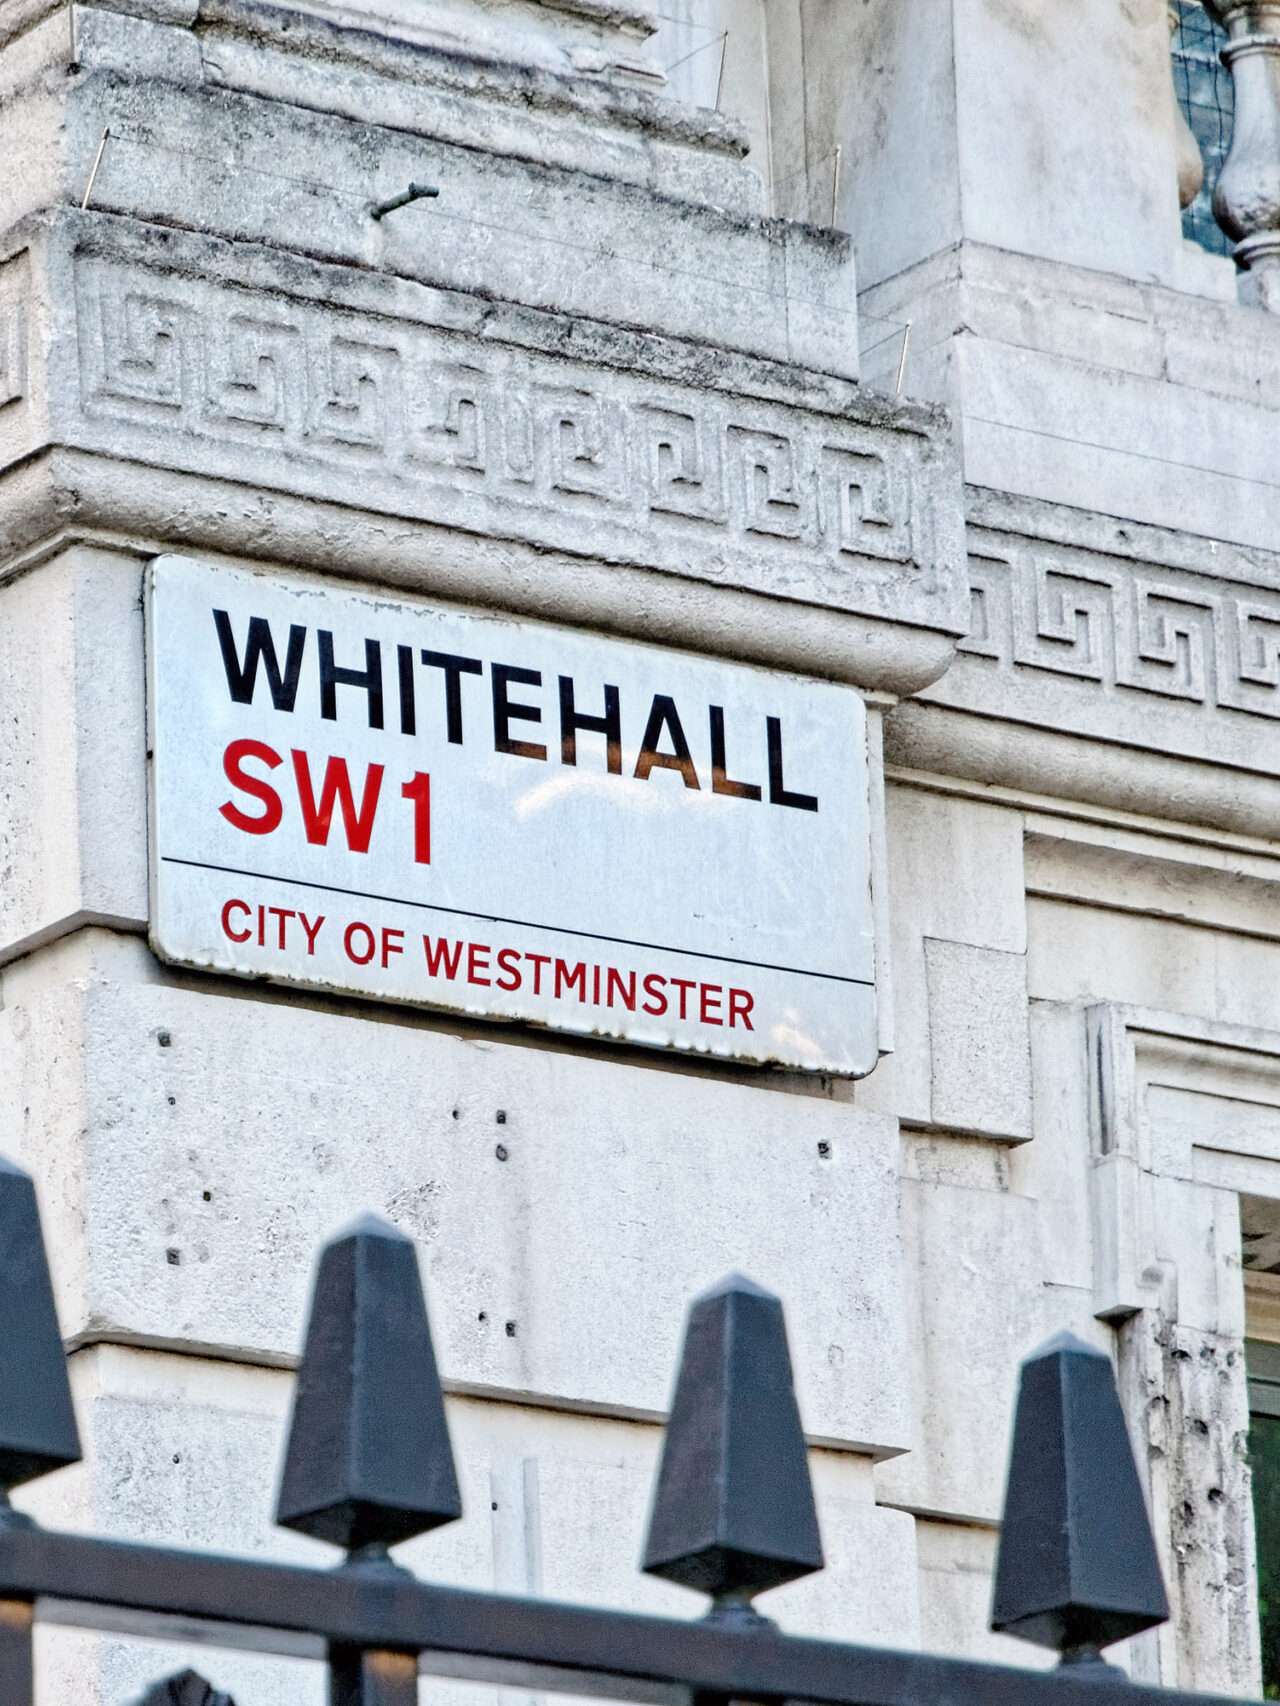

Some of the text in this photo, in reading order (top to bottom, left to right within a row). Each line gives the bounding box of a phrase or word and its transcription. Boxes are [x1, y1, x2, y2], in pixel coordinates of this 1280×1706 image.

[212, 608, 819, 813] WHITEHALL
[218, 738, 432, 866] SW1
[220, 898, 756, 1032] CITY OF WESTMINSTER
